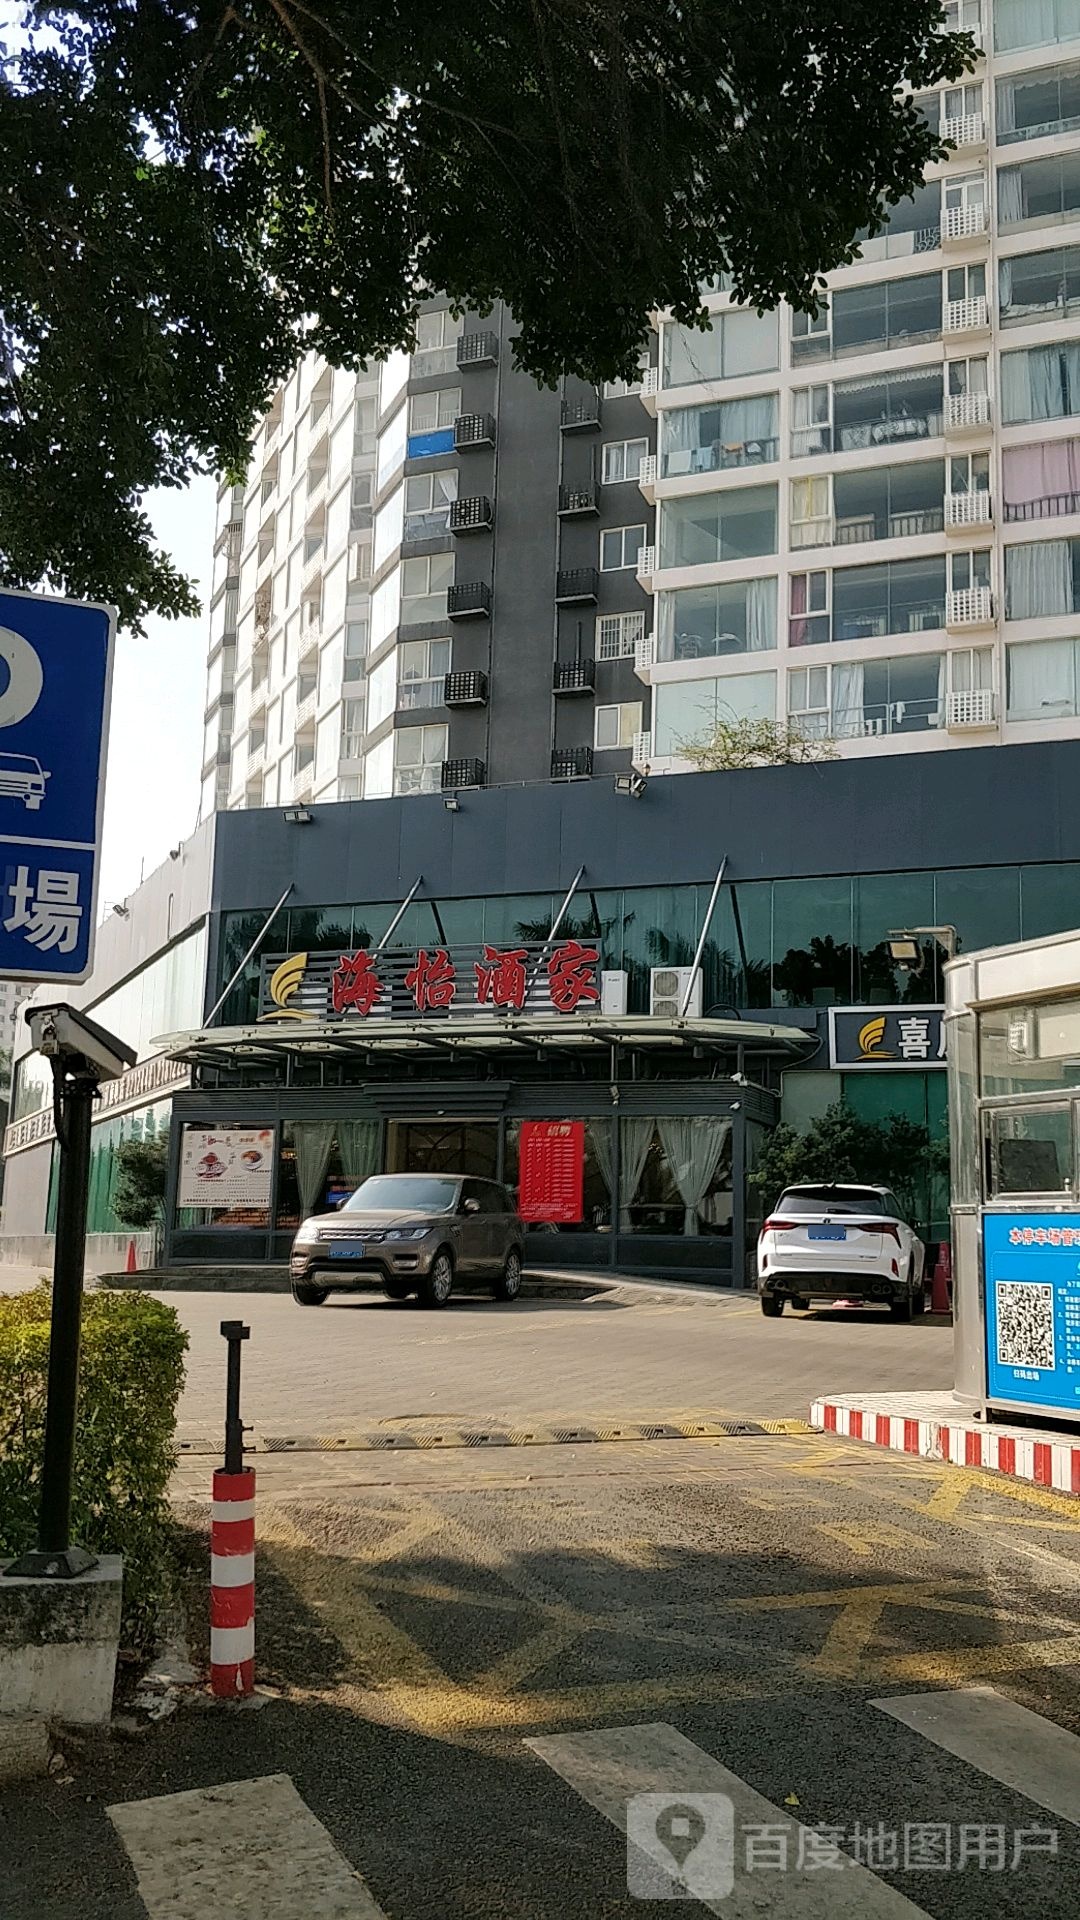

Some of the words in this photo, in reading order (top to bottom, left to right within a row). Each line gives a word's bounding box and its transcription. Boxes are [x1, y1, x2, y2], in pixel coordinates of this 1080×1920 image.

[3, 865, 83, 953] 場
[332, 940, 600, 1016] 海怡酒家
[898, 1017, 947, 1059] 喜
